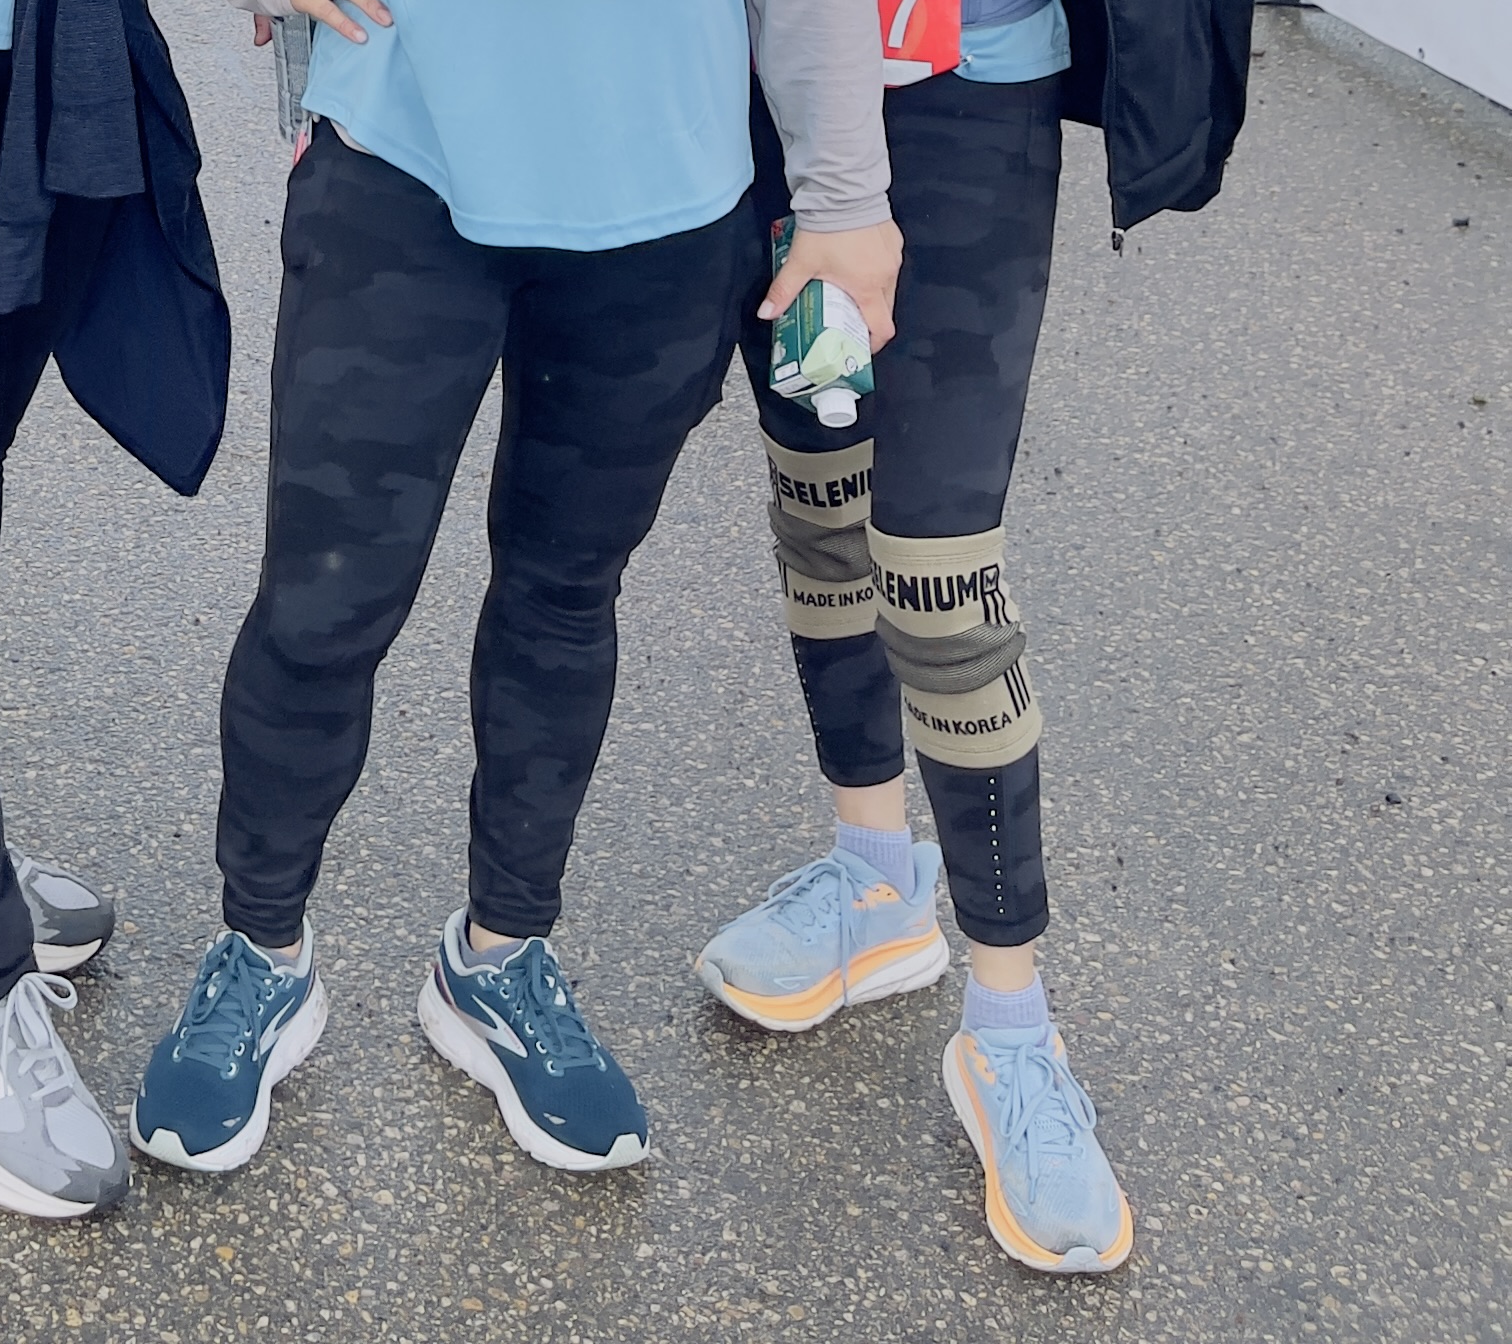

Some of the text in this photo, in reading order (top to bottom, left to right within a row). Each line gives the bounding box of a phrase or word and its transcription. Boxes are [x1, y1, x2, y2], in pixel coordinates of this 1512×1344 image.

[779, 468, 874, 508] SELENI
[793, 588, 836, 607] MADE
[838, 592, 855, 607] IN
[931, 716, 951, 734] IN
[952, 711, 1012, 735] KOREA
